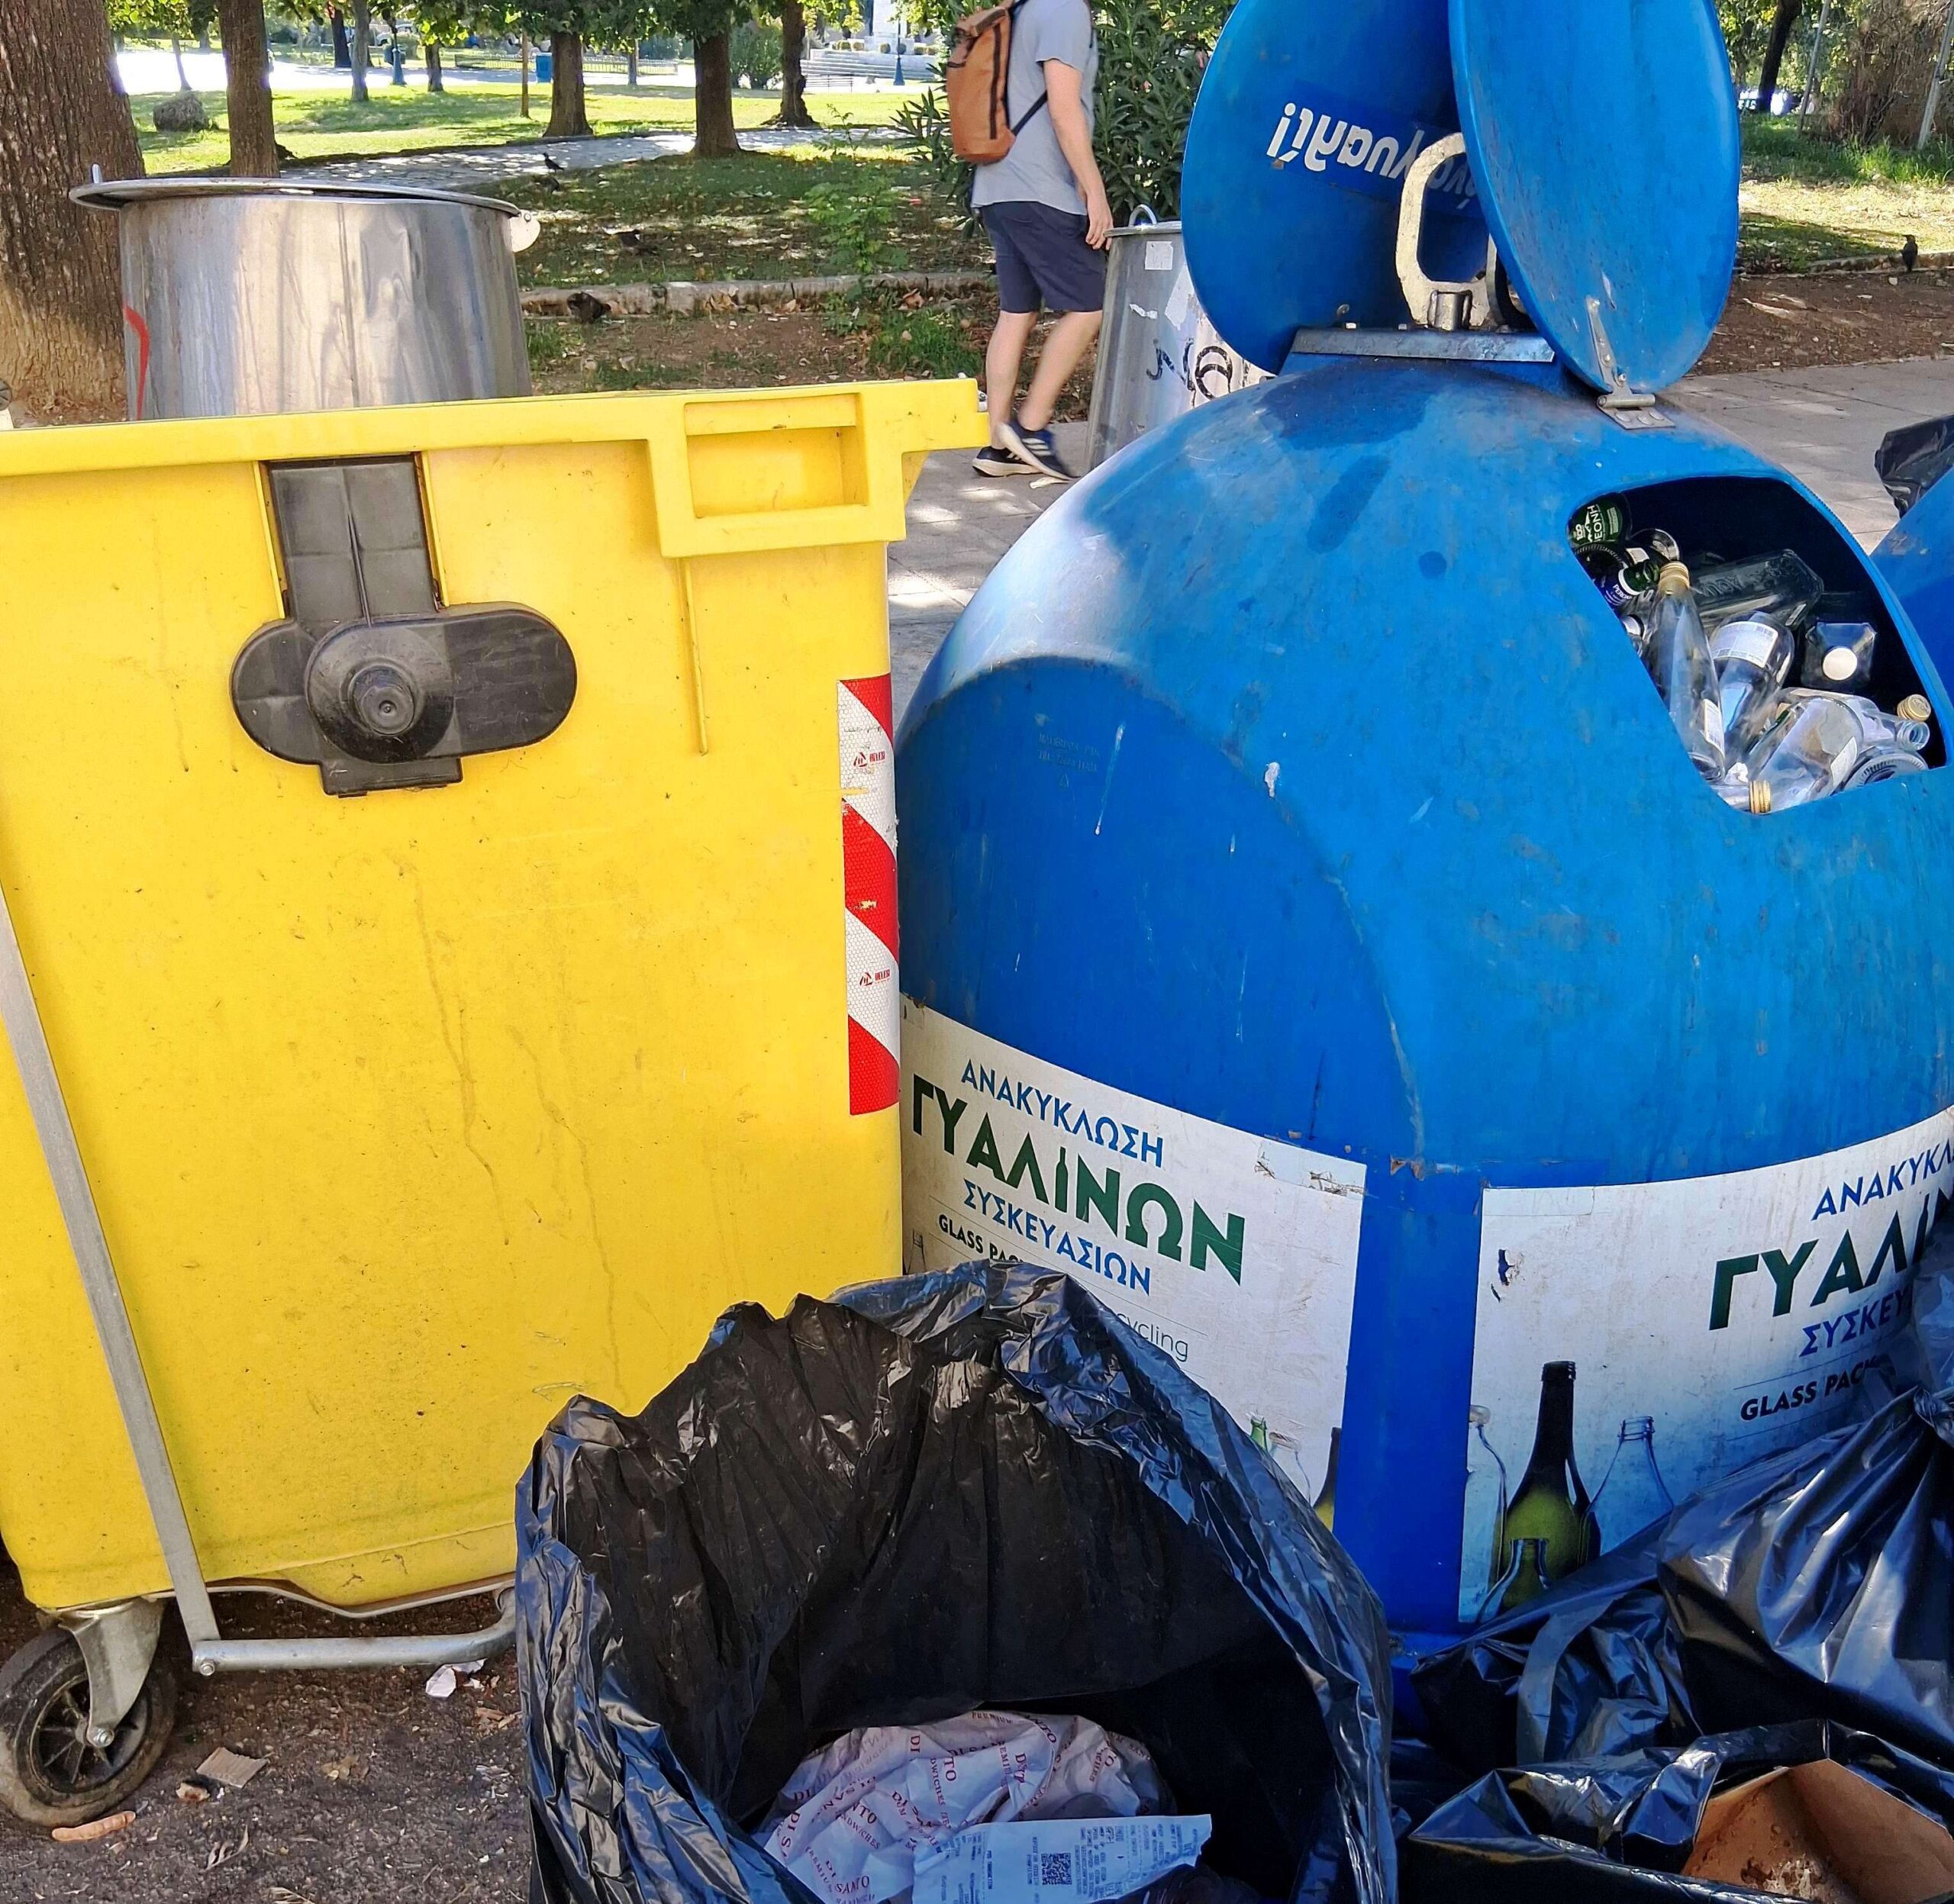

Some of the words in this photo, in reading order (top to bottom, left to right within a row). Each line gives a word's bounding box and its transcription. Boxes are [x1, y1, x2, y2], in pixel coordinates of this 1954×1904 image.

[961, 1058, 1164, 1168] ΑΝΑΚΥΚΛΩΣΗ
[1811, 1138, 1954, 1221] ΑΝΑΚΥΚΛ
[938, 1214, 984, 1255] GLASS
[963, 1179, 1151, 1296] ΣΥΣΚΕΥΑΣΙΩΝ
[1799, 1286, 1908, 1358] ΣΥΣΚΕΥ
[1740, 1381, 1817, 1421] GLASS
[910, 1735, 921, 1753] DI
